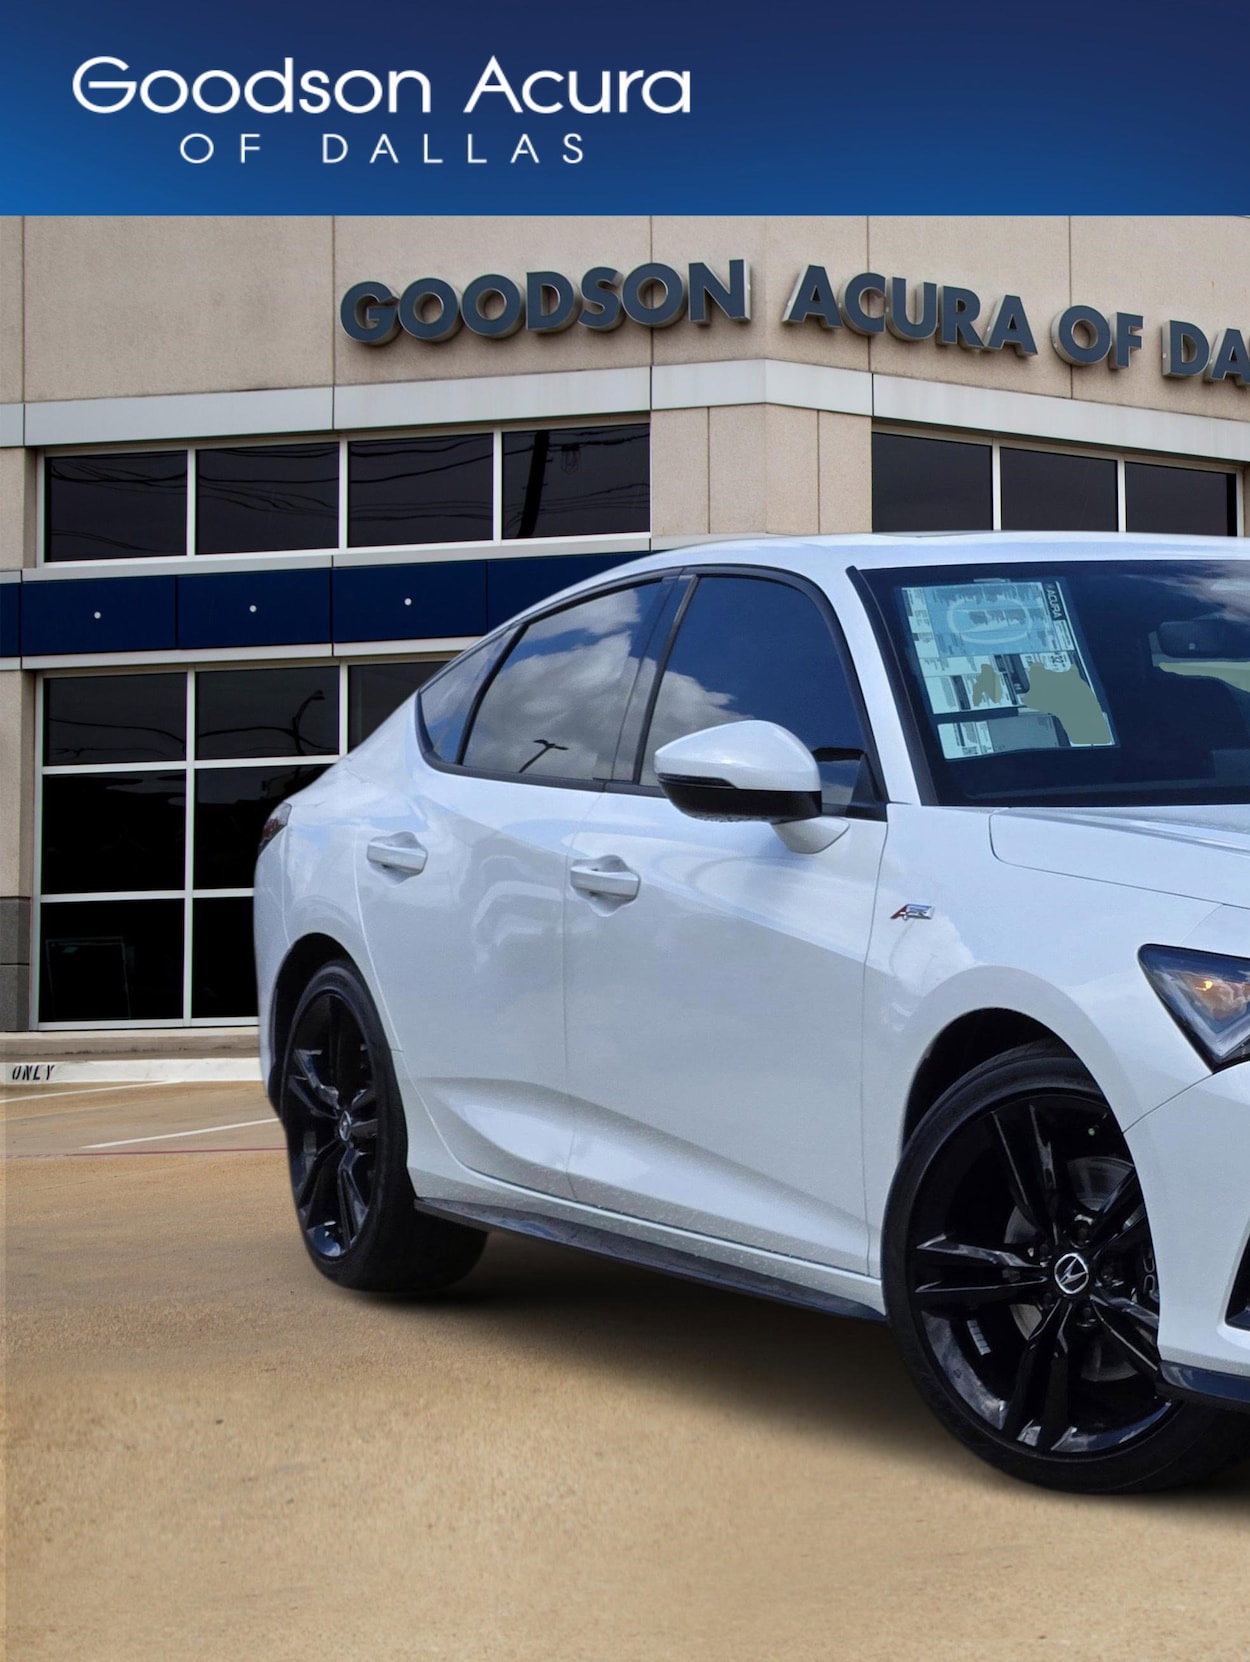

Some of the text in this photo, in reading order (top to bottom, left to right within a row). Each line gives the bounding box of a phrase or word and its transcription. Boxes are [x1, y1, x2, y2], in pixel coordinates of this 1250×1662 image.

[340, 259, 750, 345] GOODSON
[783, 264, 1038, 355] ACURA
[1051, 305, 1143, 368] OF
[12, 1064, 55, 1081] ONLY
